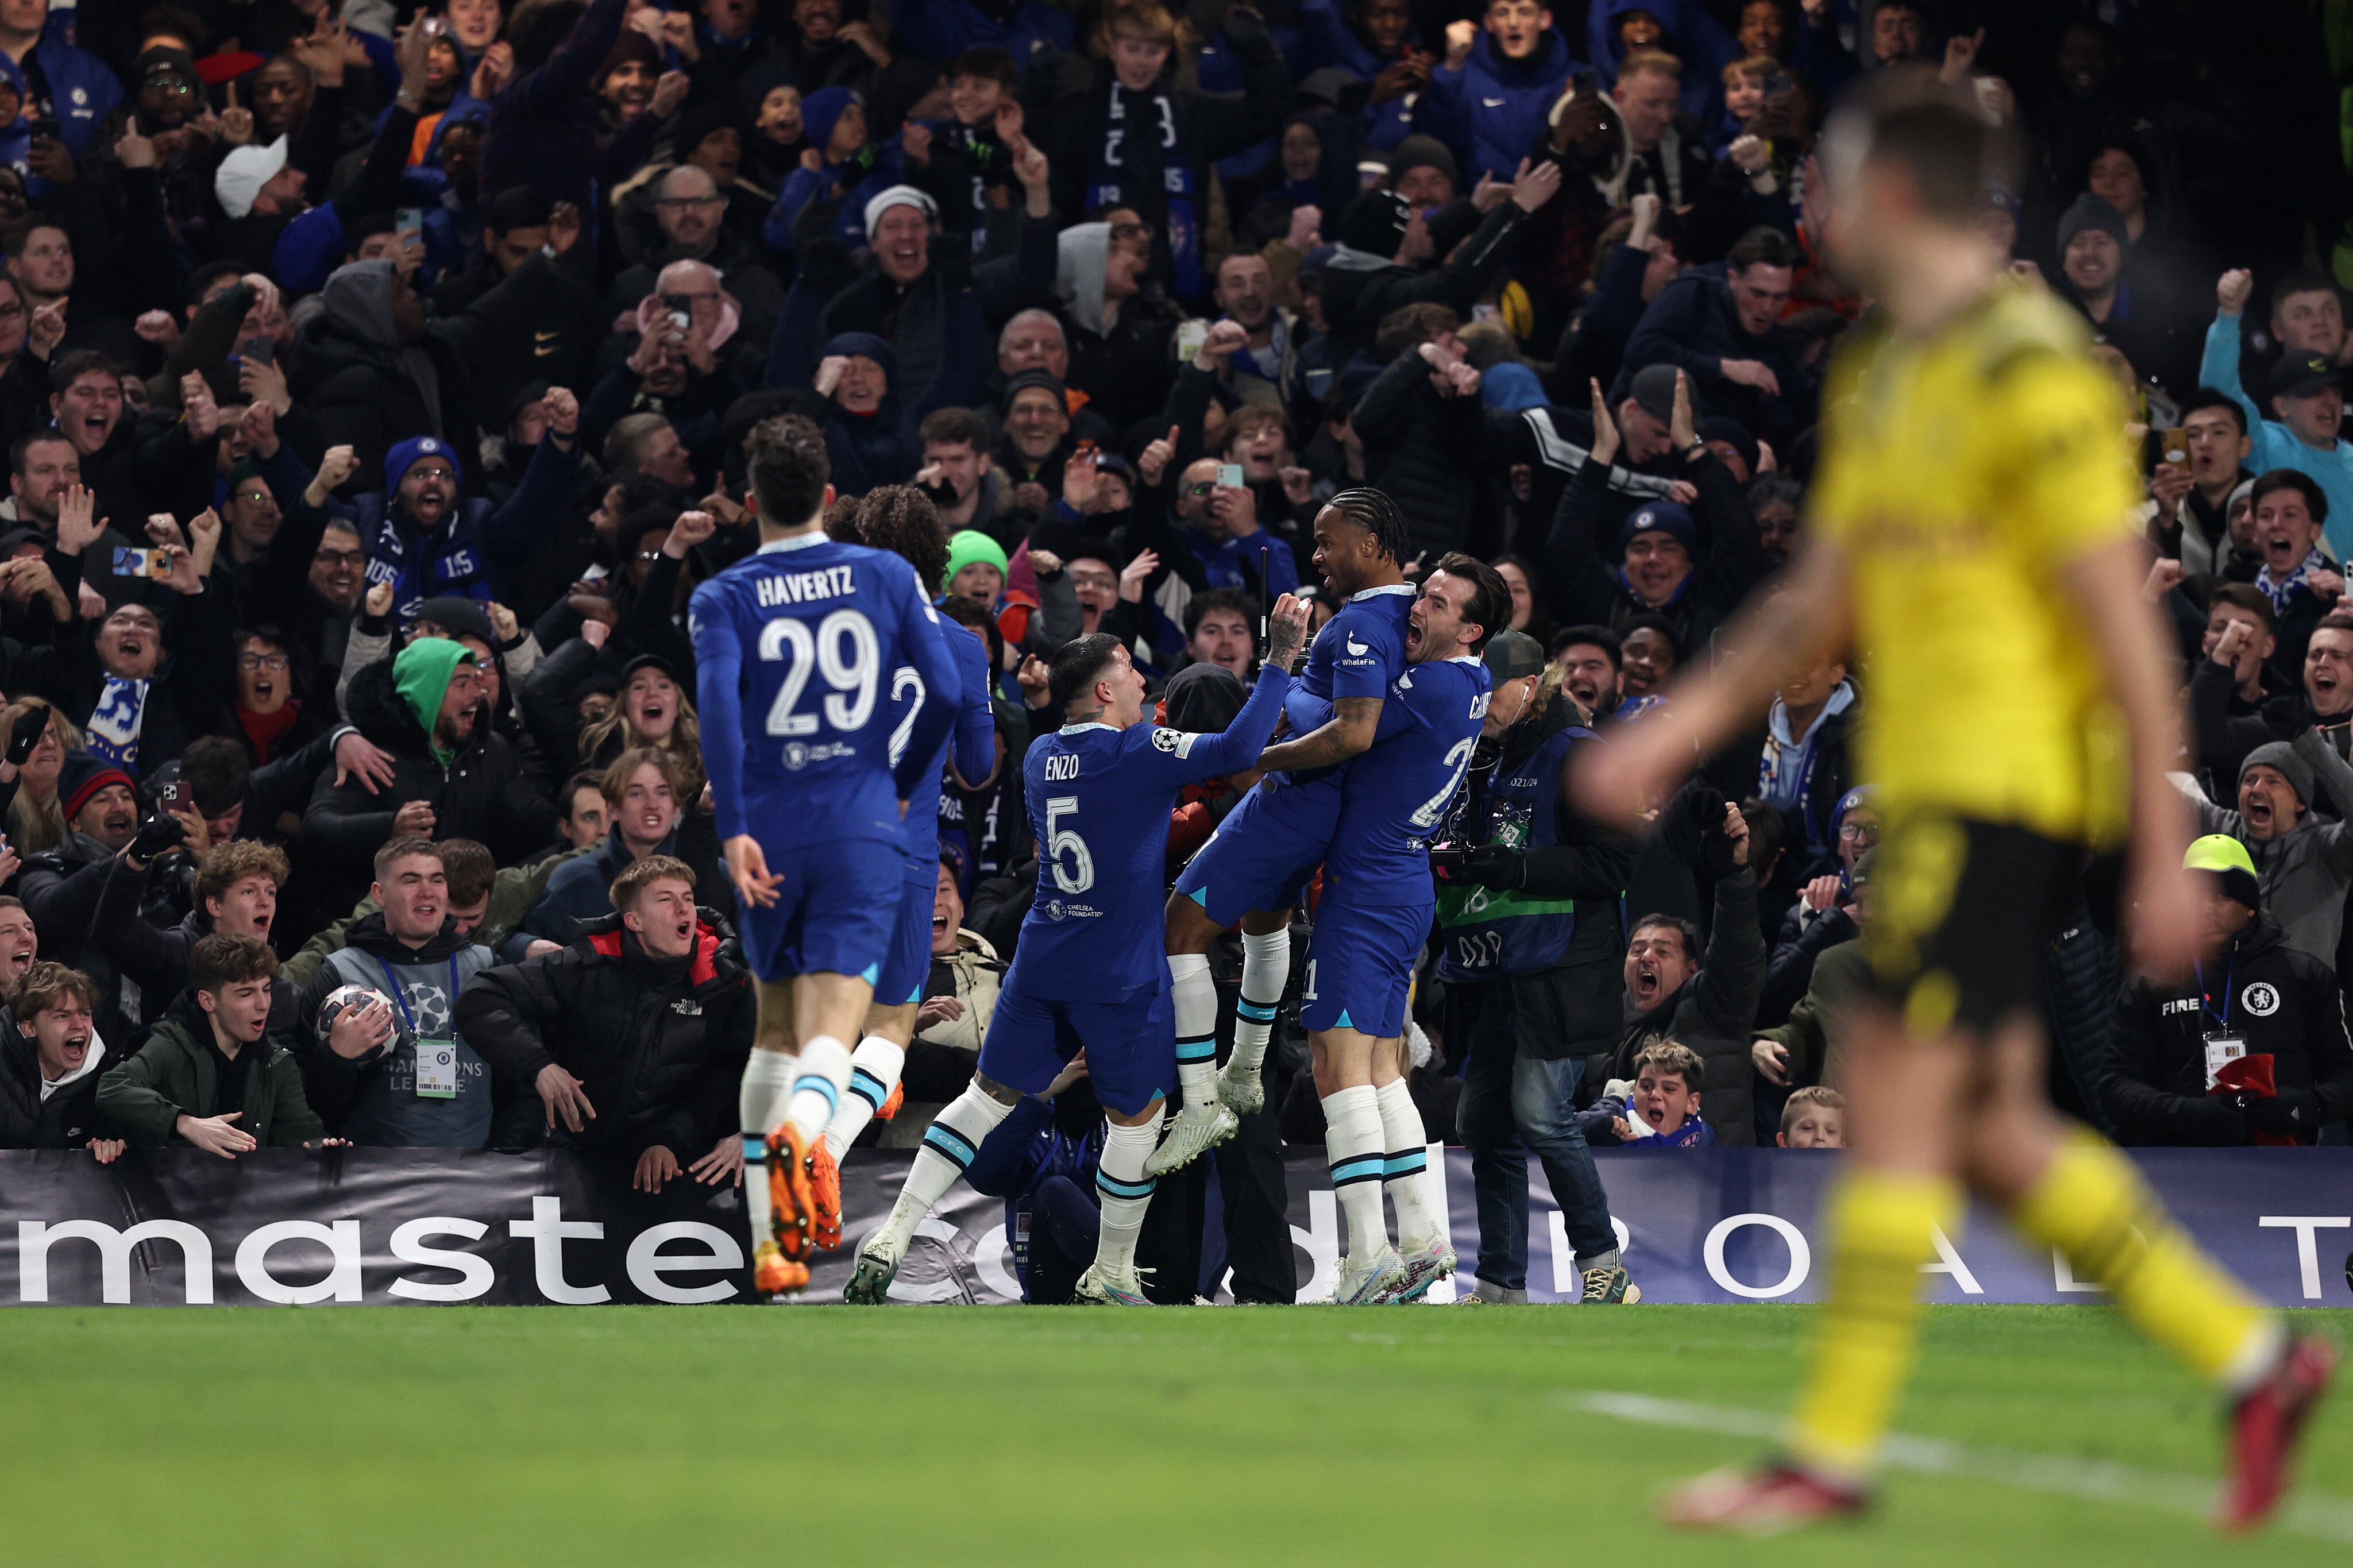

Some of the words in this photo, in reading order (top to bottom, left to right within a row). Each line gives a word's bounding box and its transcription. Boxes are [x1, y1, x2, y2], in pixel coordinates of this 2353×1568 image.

[755, 565, 857, 607] HAVERTZ
[758, 608, 880, 737] 29
[1045, 754, 1079, 781] ENZO
[1409, 731, 1482, 828] 2
[1508, 778, 1538, 787] 021/24
[1046, 796, 1094, 894] 5
[1506, 828, 1516, 840] Pg
[1303, 959, 1318, 1001] 1
[2162, 998, 2200, 1016] FIRE
[390, 1076, 466, 1092] LEE
[938, 1135, 964, 1153] CFC
[18, 1190, 1341, 1306] mastecd
[2259, 1216, 2351, 1299] T
